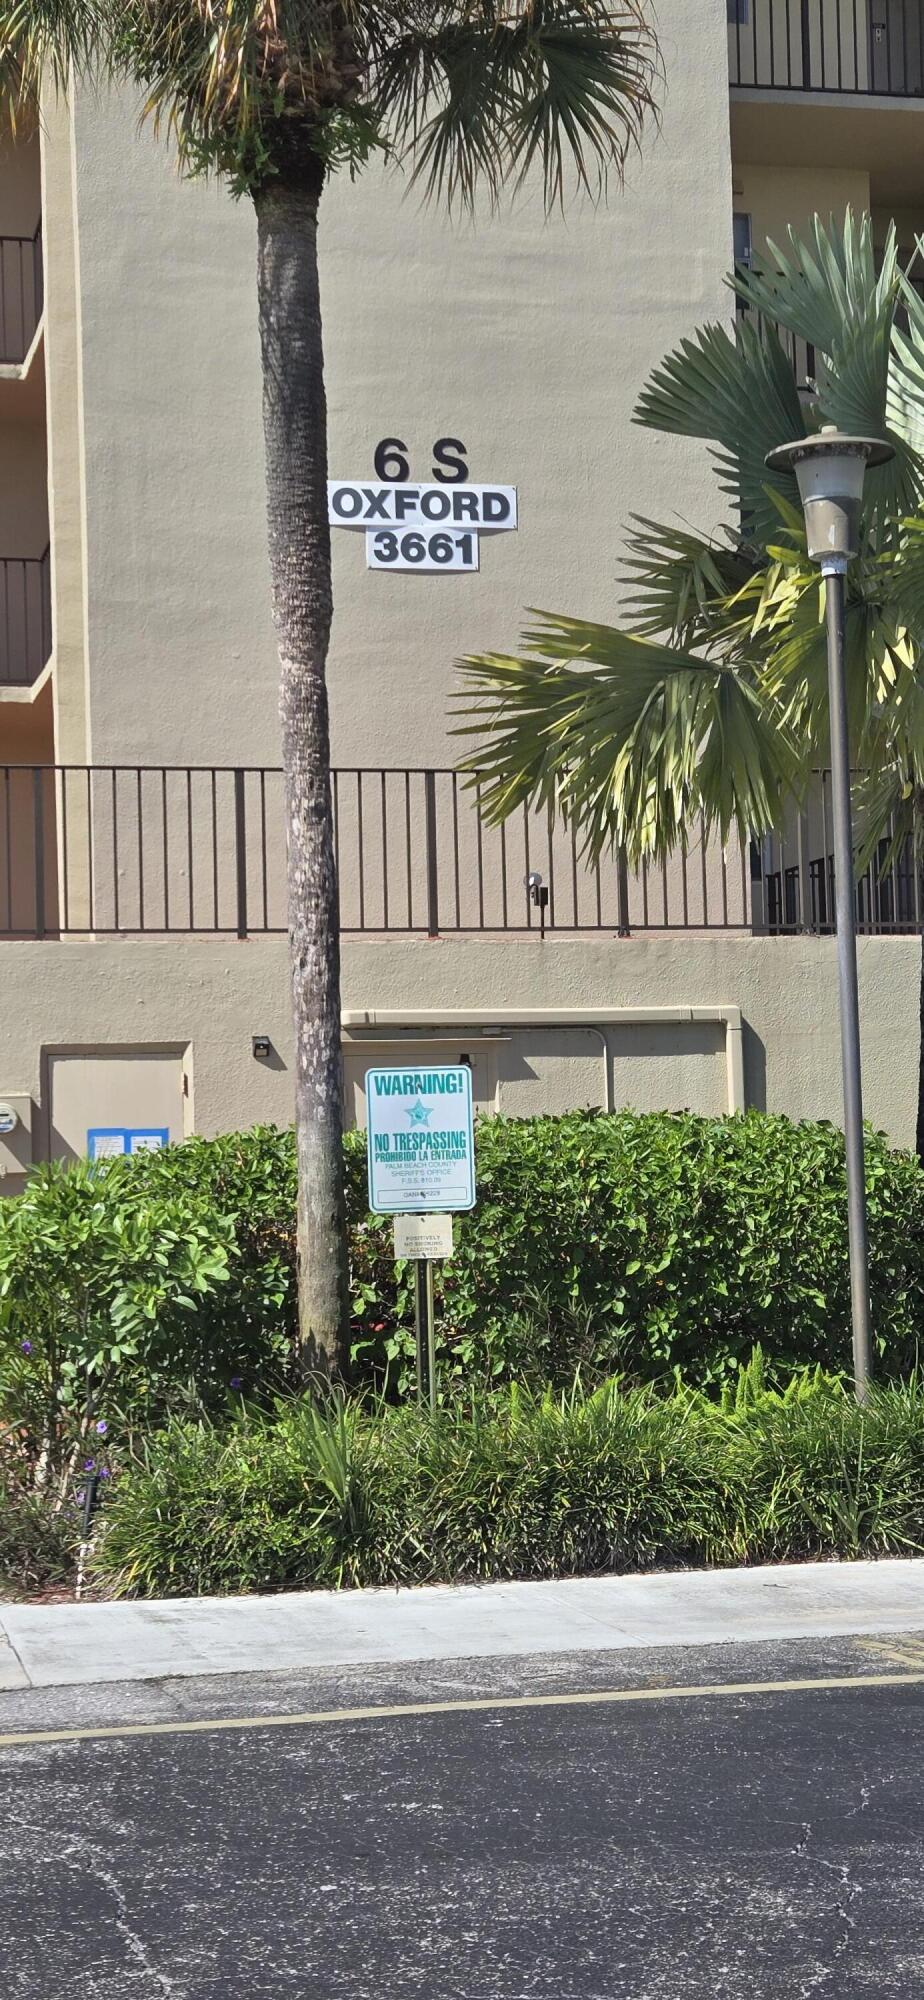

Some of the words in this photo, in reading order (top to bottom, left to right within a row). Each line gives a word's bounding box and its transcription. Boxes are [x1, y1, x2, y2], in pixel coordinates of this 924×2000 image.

[374, 437, 410, 483] 6
[431, 437, 469, 484] S
[332, 487, 511, 522] OXFORD
[373, 531, 473, 565] 3661
[374, 1073, 464, 1096] WARNING!
[374, 1133, 390, 1152] NO
[392, 1131, 467, 1151] TRESPASSING
[375, 1151, 417, 1163] PROHIBIDO
[419, 1151, 429, 1161] LA
[431, 1150, 467, 1160] ENTRADA
[391, 1169, 425, 1177] SHERIFF'S
